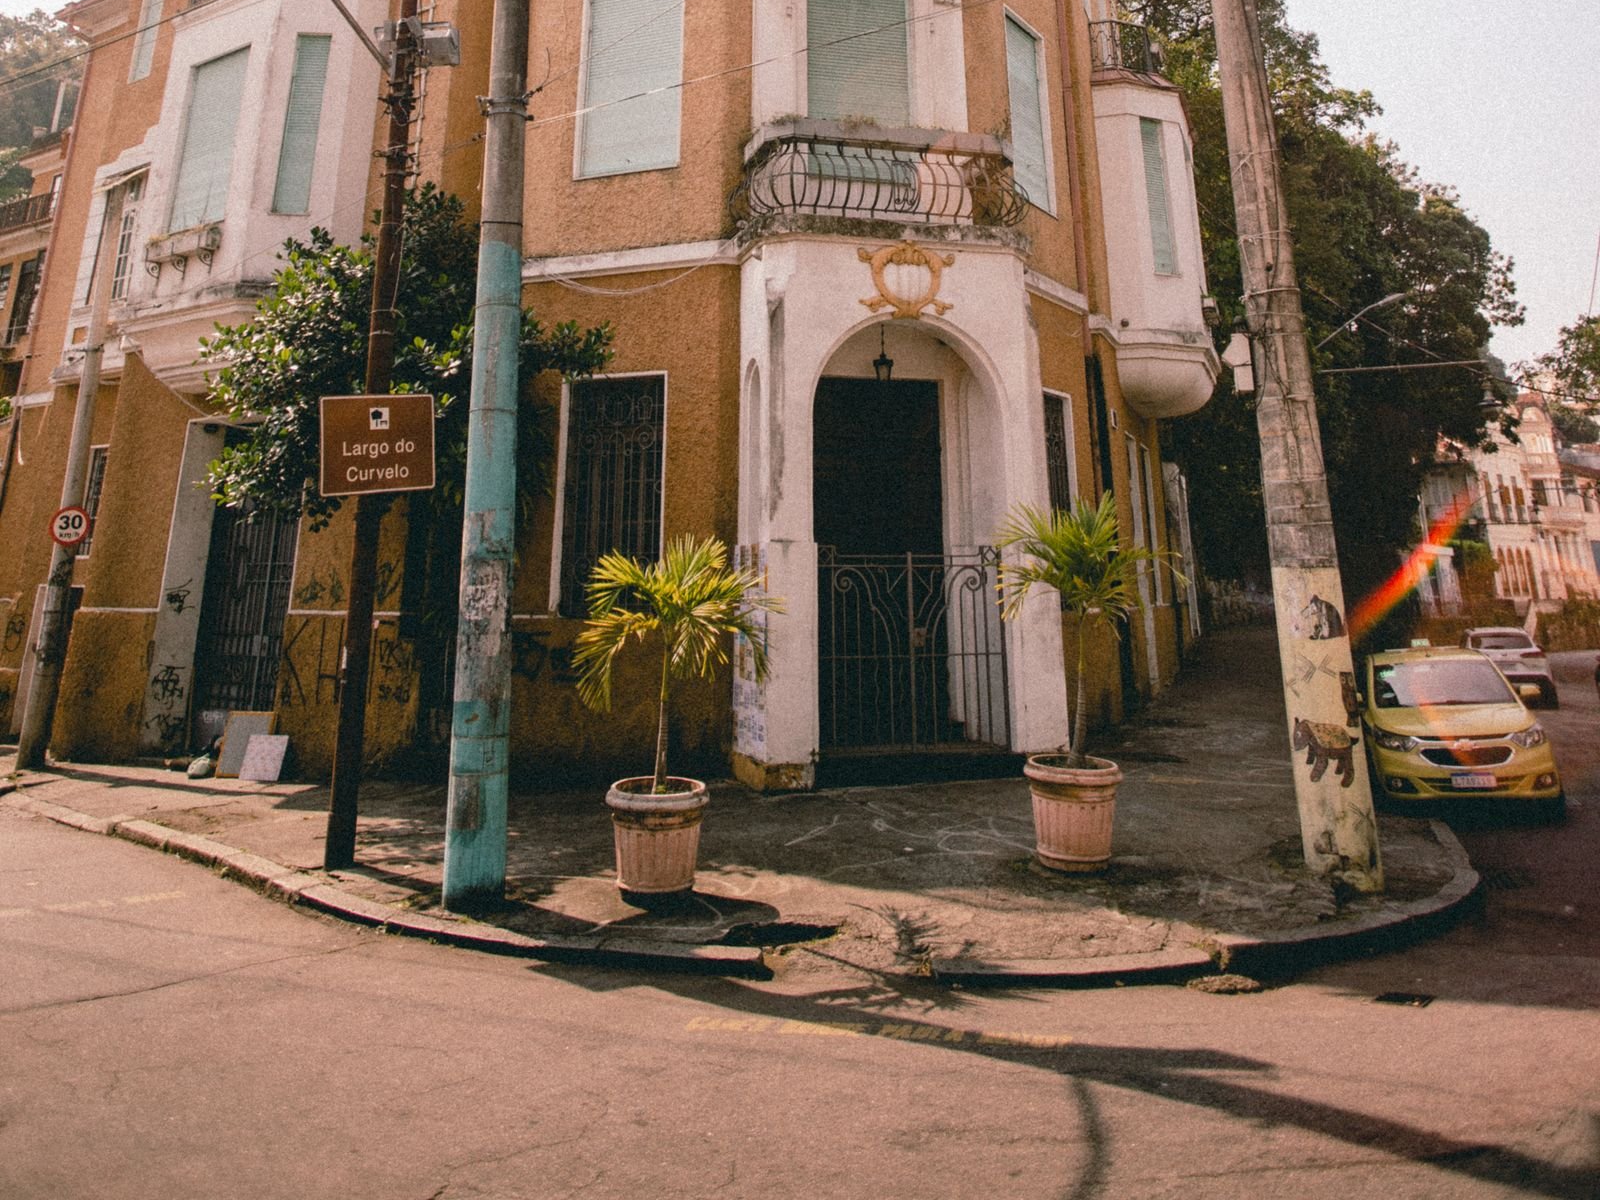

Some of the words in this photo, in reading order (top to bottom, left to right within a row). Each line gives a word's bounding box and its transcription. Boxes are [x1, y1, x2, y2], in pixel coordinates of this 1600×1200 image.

[342, 441, 389, 458] Largo
[395, 438, 415, 453] do
[346, 463, 409, 482] Curvelo
[59, 514, 83, 530] 30
